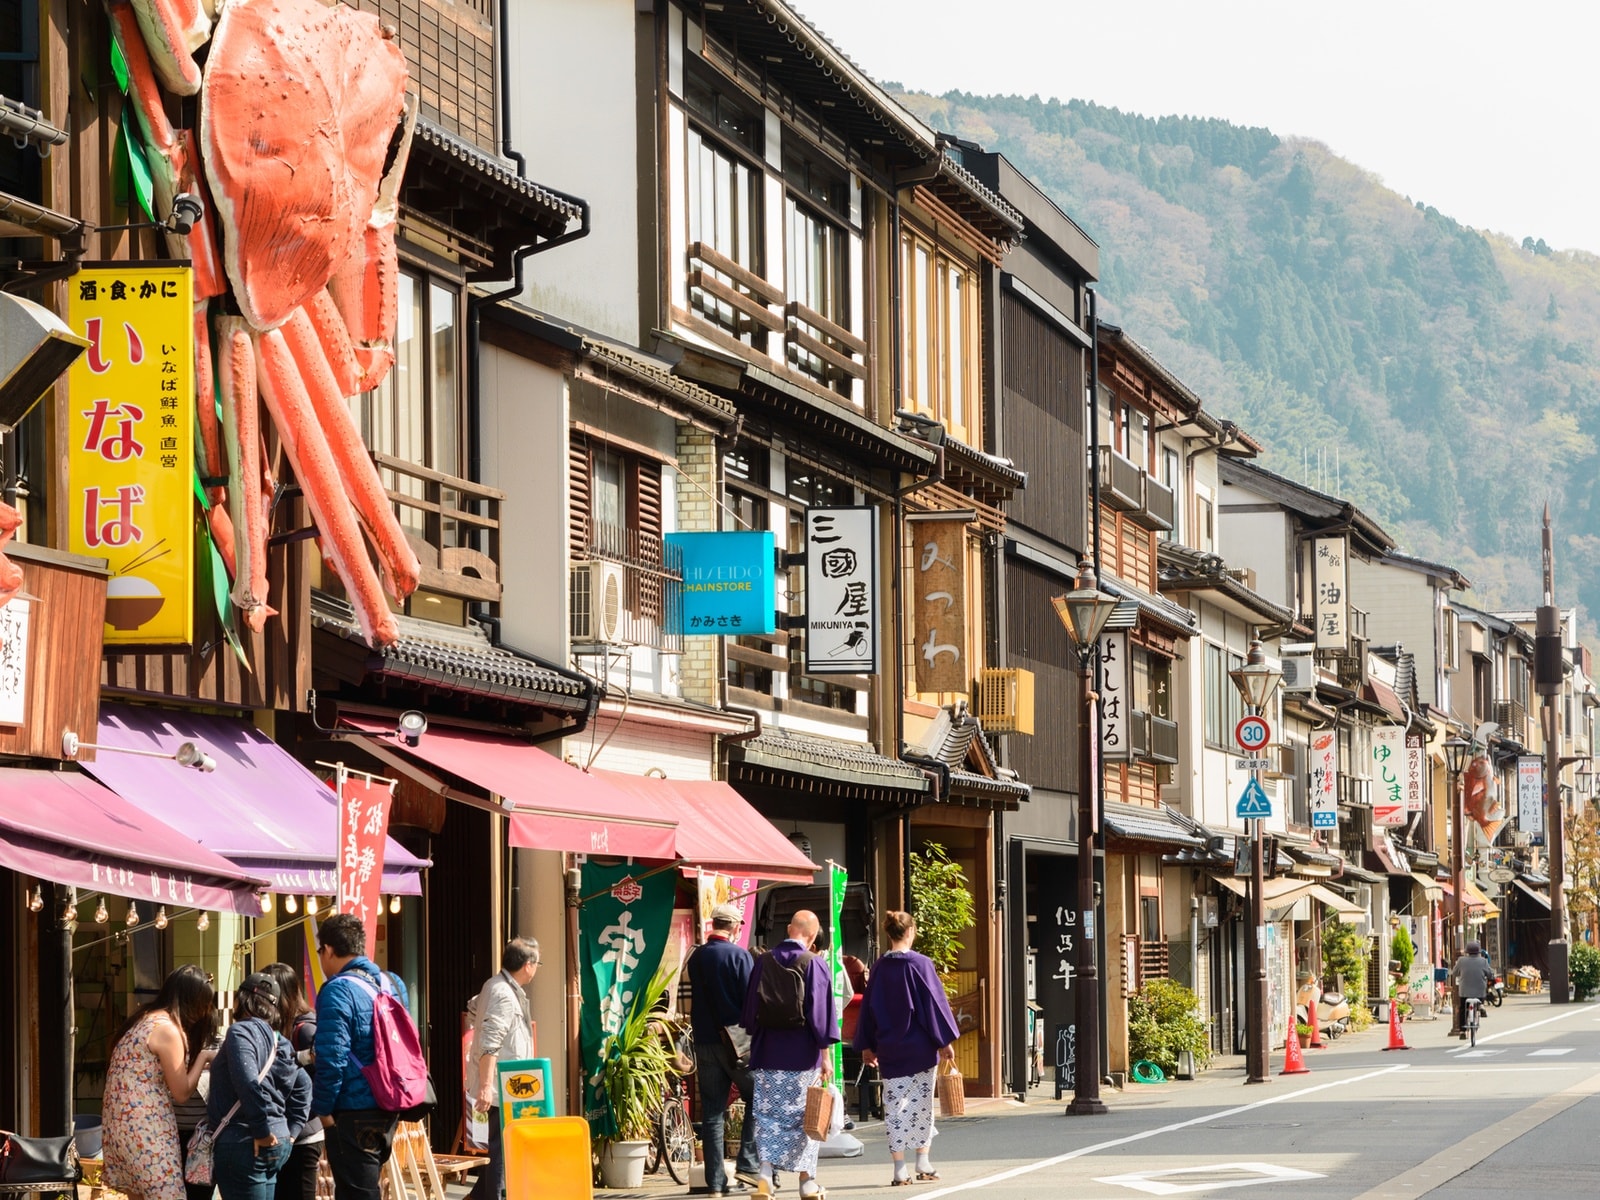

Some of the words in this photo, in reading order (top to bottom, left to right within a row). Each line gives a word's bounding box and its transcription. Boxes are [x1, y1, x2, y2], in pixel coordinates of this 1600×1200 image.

[83, 317, 146, 548] いなば
[810, 515, 870, 617] 三國屋
[1317, 546, 1341, 567] 旅館
[690, 615, 742, 628] かみさき
[920, 541, 960, 669] みつわ
[1320, 582, 1341, 636] 油屋
[811, 621, 853, 630] MIKUNIYA
[1101, 638, 1120, 746] よしはる
[1243, 726, 1263, 742] 30
[1407, 735, 1420, 749] 酒
[1238, 760, 1269, 769] 区域内
[1373, 744, 1403, 802] ゆしま
